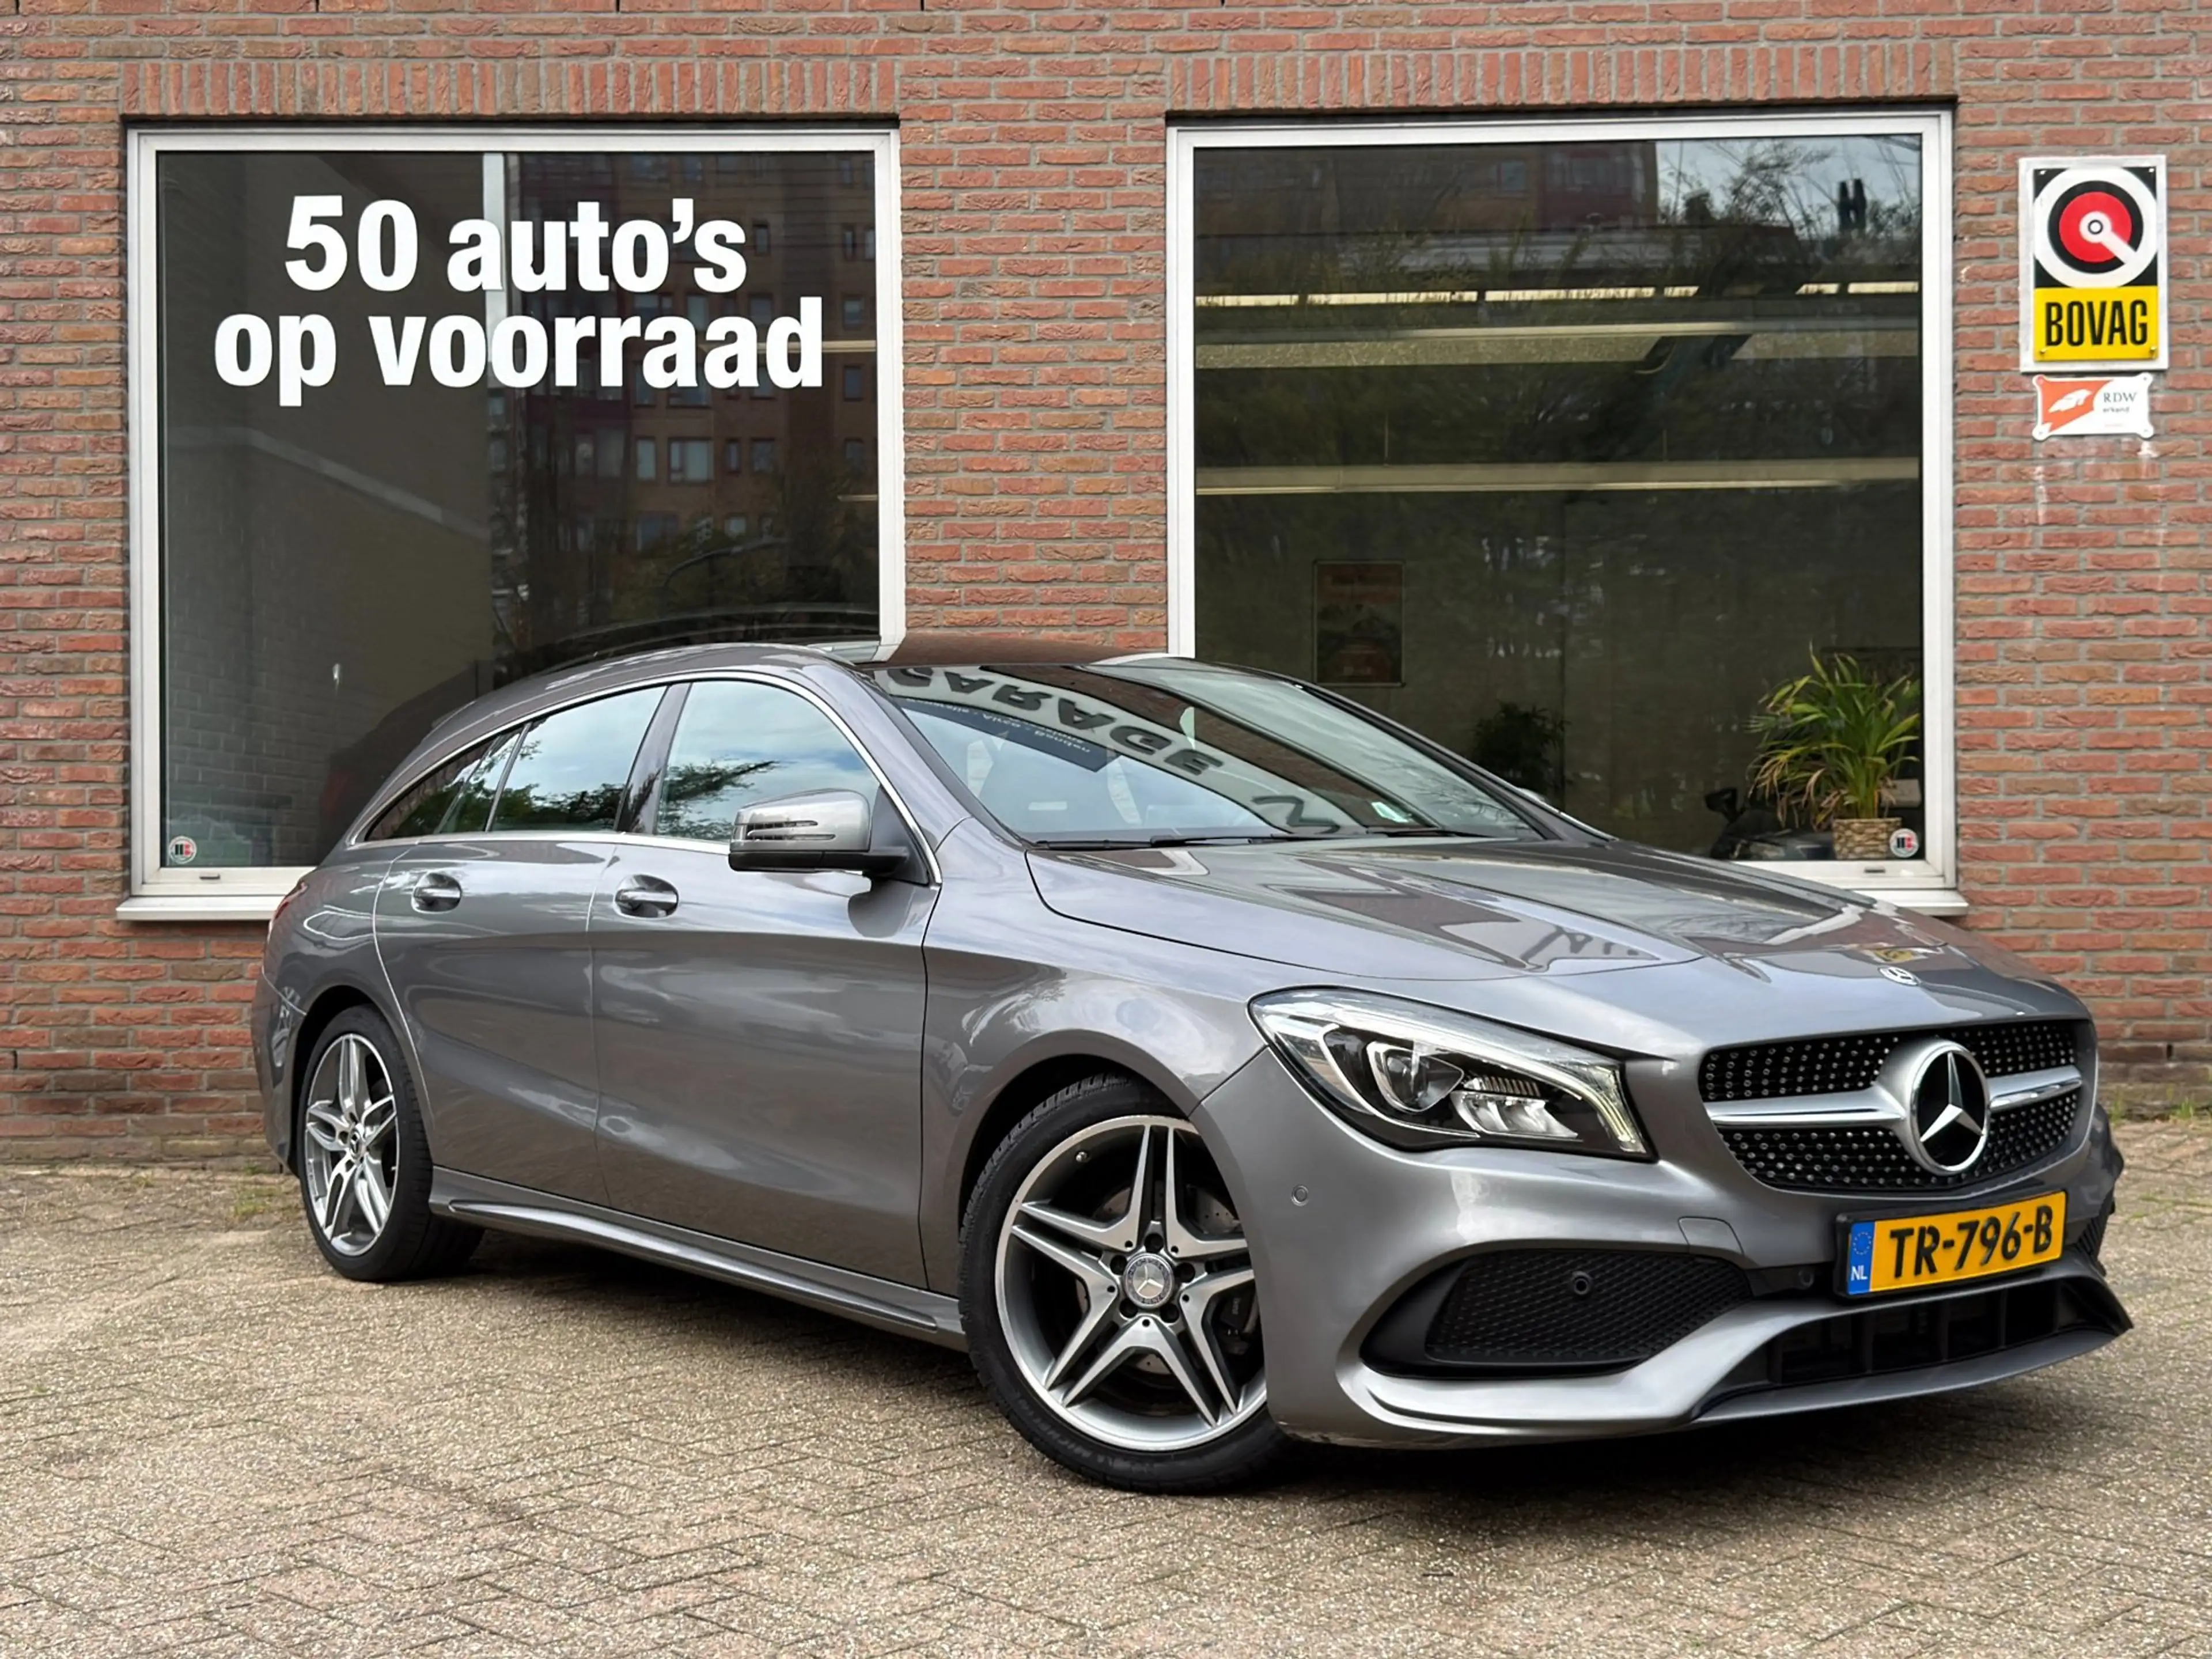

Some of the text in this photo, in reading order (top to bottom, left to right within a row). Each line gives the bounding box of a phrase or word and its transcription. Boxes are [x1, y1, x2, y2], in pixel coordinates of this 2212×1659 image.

[285, 195, 747, 293] 50 auto’s
[214, 296, 823, 407] op voorraad
[2046, 299, 2148, 347] BOVAG
[2103, 392, 2137, 403] RDW
[1889, 1205, 2053, 1278] TR-796-B
[1851, 1265, 1868, 1281] NL
